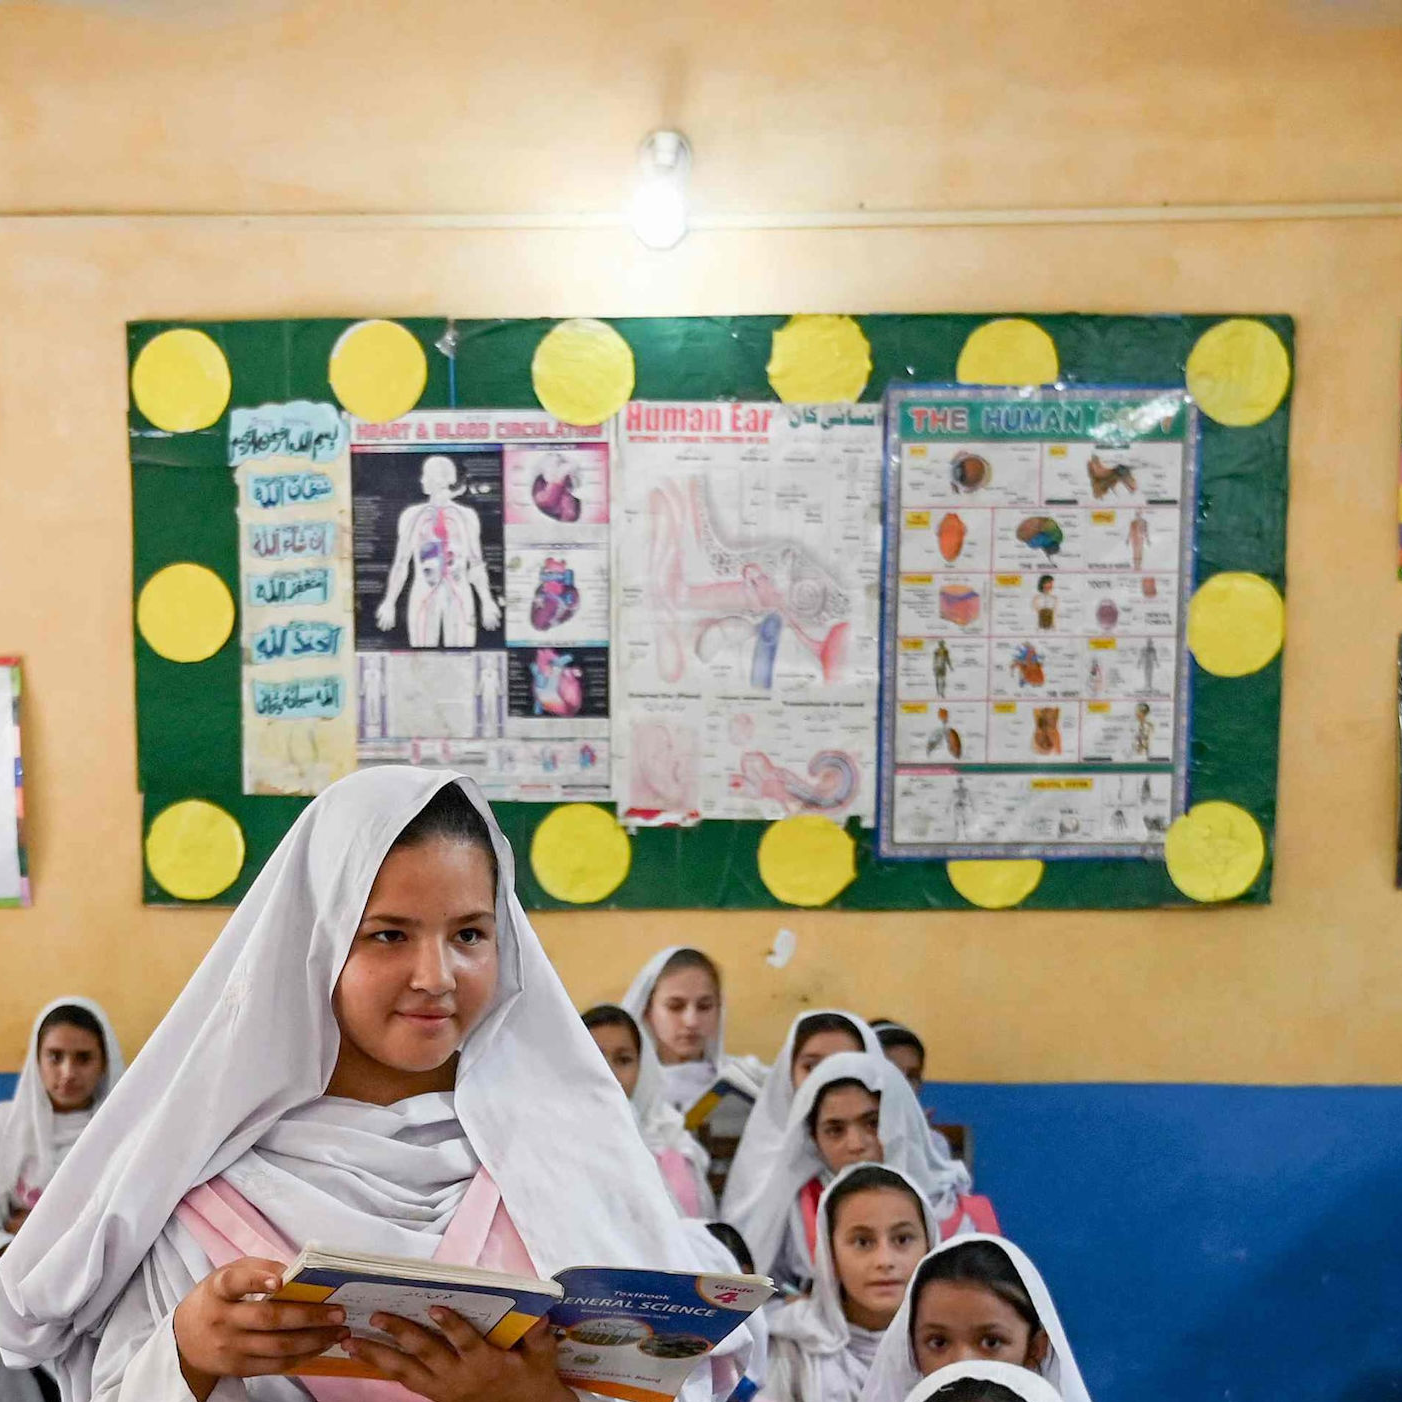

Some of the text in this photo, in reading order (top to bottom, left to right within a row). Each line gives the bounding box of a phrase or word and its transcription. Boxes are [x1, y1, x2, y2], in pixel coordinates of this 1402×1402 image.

[626, 403, 773, 432] Human Ear
[910, 407, 970, 434] THE
[982, 406, 1083, 434] HUMAN
[356, 423, 411, 440] HEART
[416, 423, 429, 440] &
[435, 423, 490, 440] BLOOD
[613, 1290, 671, 1301] Textbook
[714, 1292, 738, 1304] 4
[638, 1300, 718, 1318] SCIENCE
